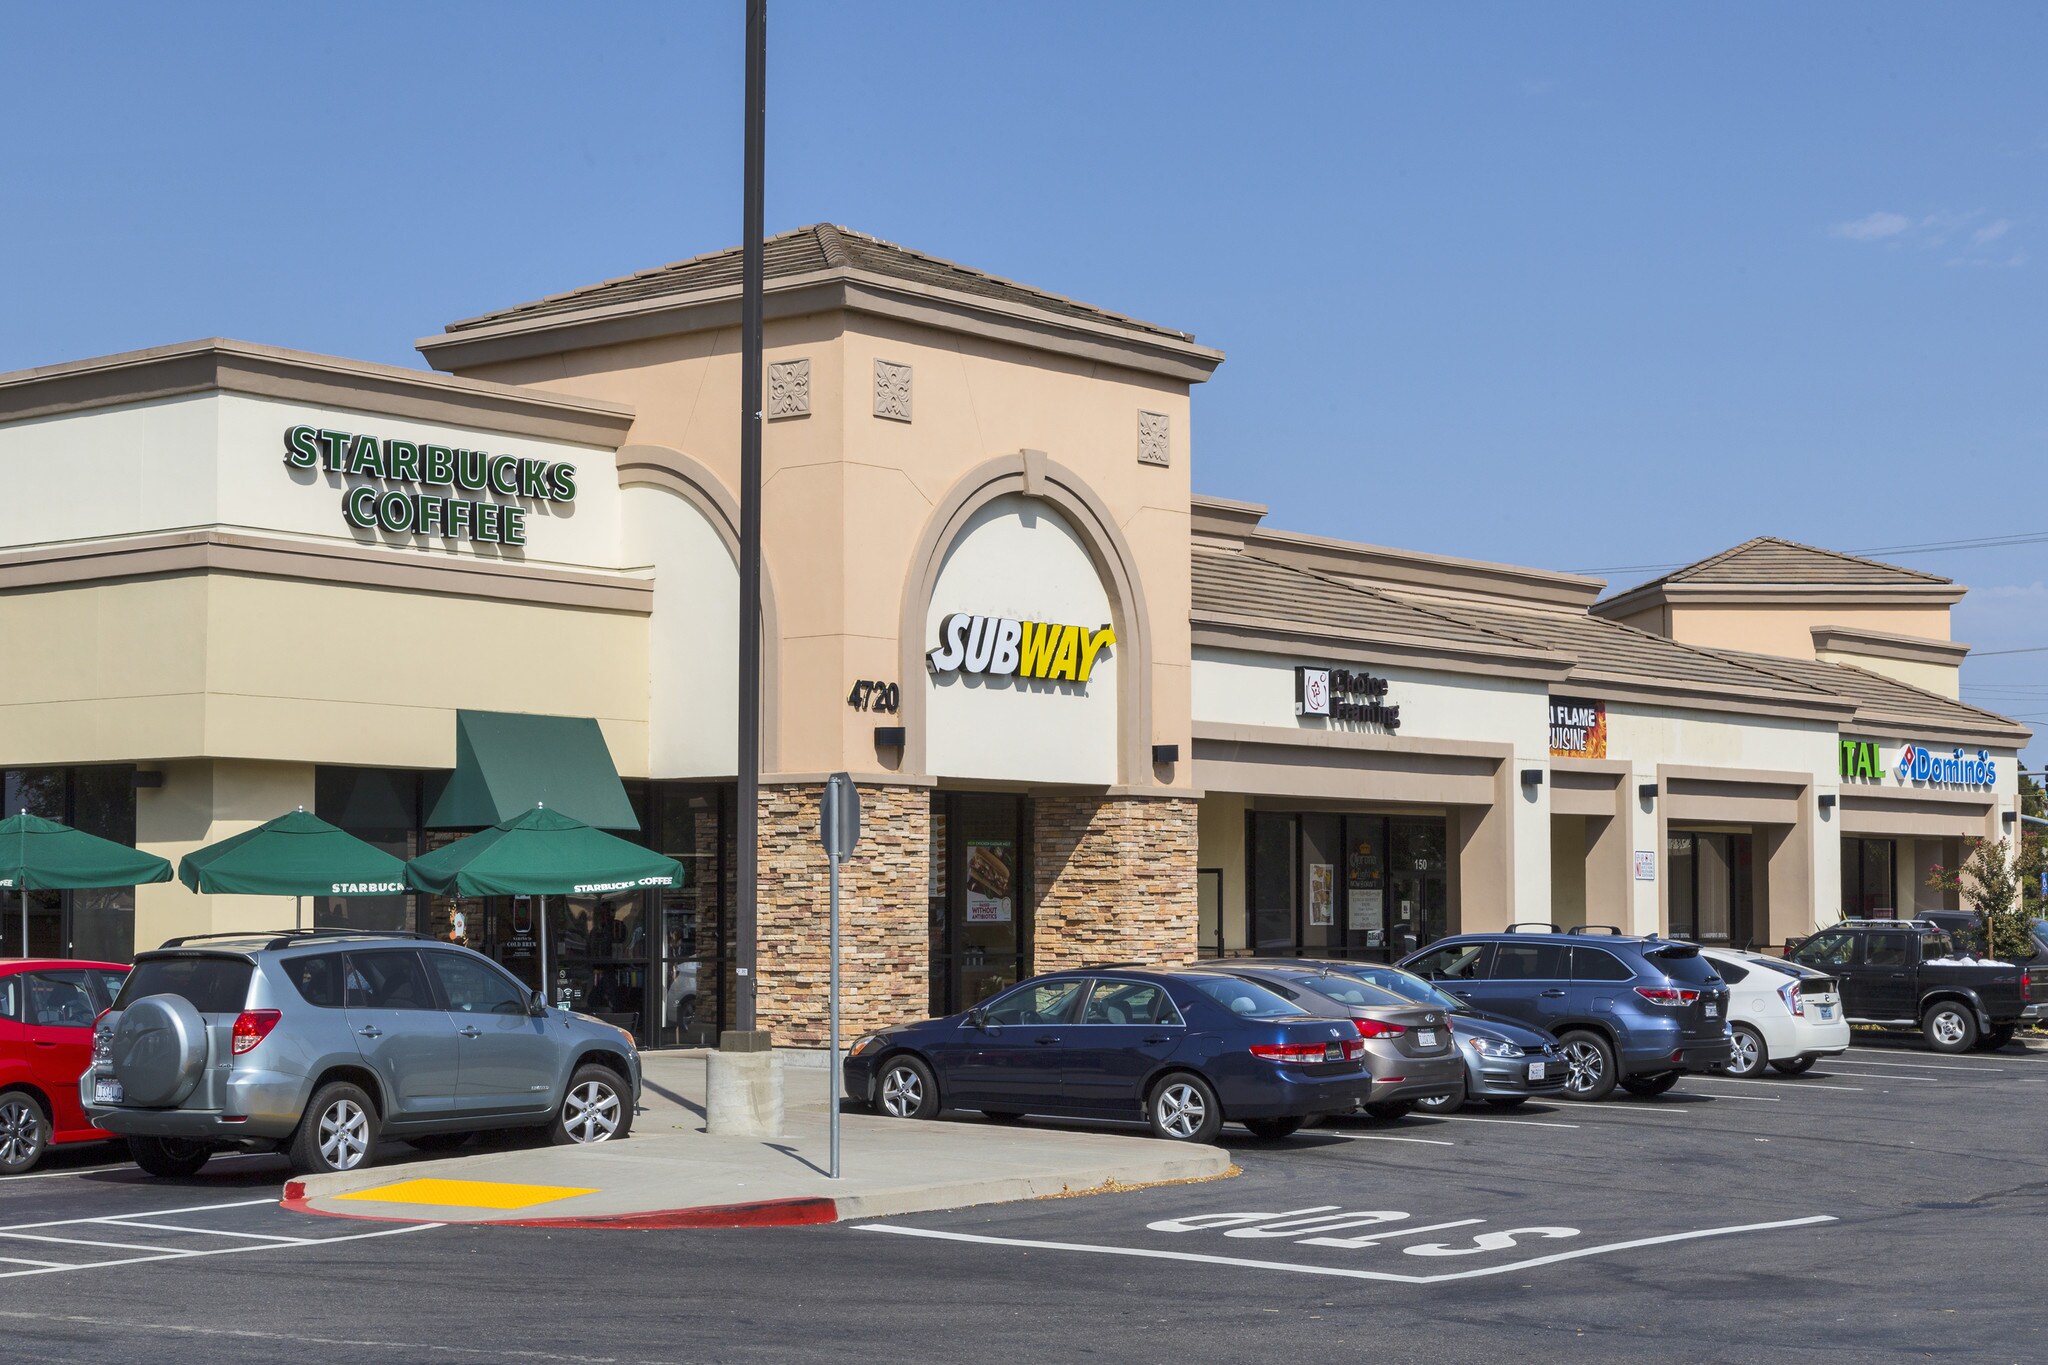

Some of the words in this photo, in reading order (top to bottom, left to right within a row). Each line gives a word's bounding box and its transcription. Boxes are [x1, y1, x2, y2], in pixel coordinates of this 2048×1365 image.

[284, 424, 577, 502] STARBUCKS
[342, 485, 527, 546] COFFEE
[927, 613, 1117, 682] SUBWAY
[847, 680, 899, 713] 4720
[1331, 669, 1388, 696] Choice
[1330, 697, 1400, 728] Framing
[1557, 706, 1596, 727] FLAME
[1550, 727, 1587, 751] UISINE
[1911, 746, 1997, 785] Domino's
[1414, 859, 1428, 870] 150
[332, 882, 408, 893] STARBUCK
[574, 880, 636, 893] STARBUCKS
[638, 876, 673, 886] COFFEE
[1146, 1205, 1581, 1256] STOP
